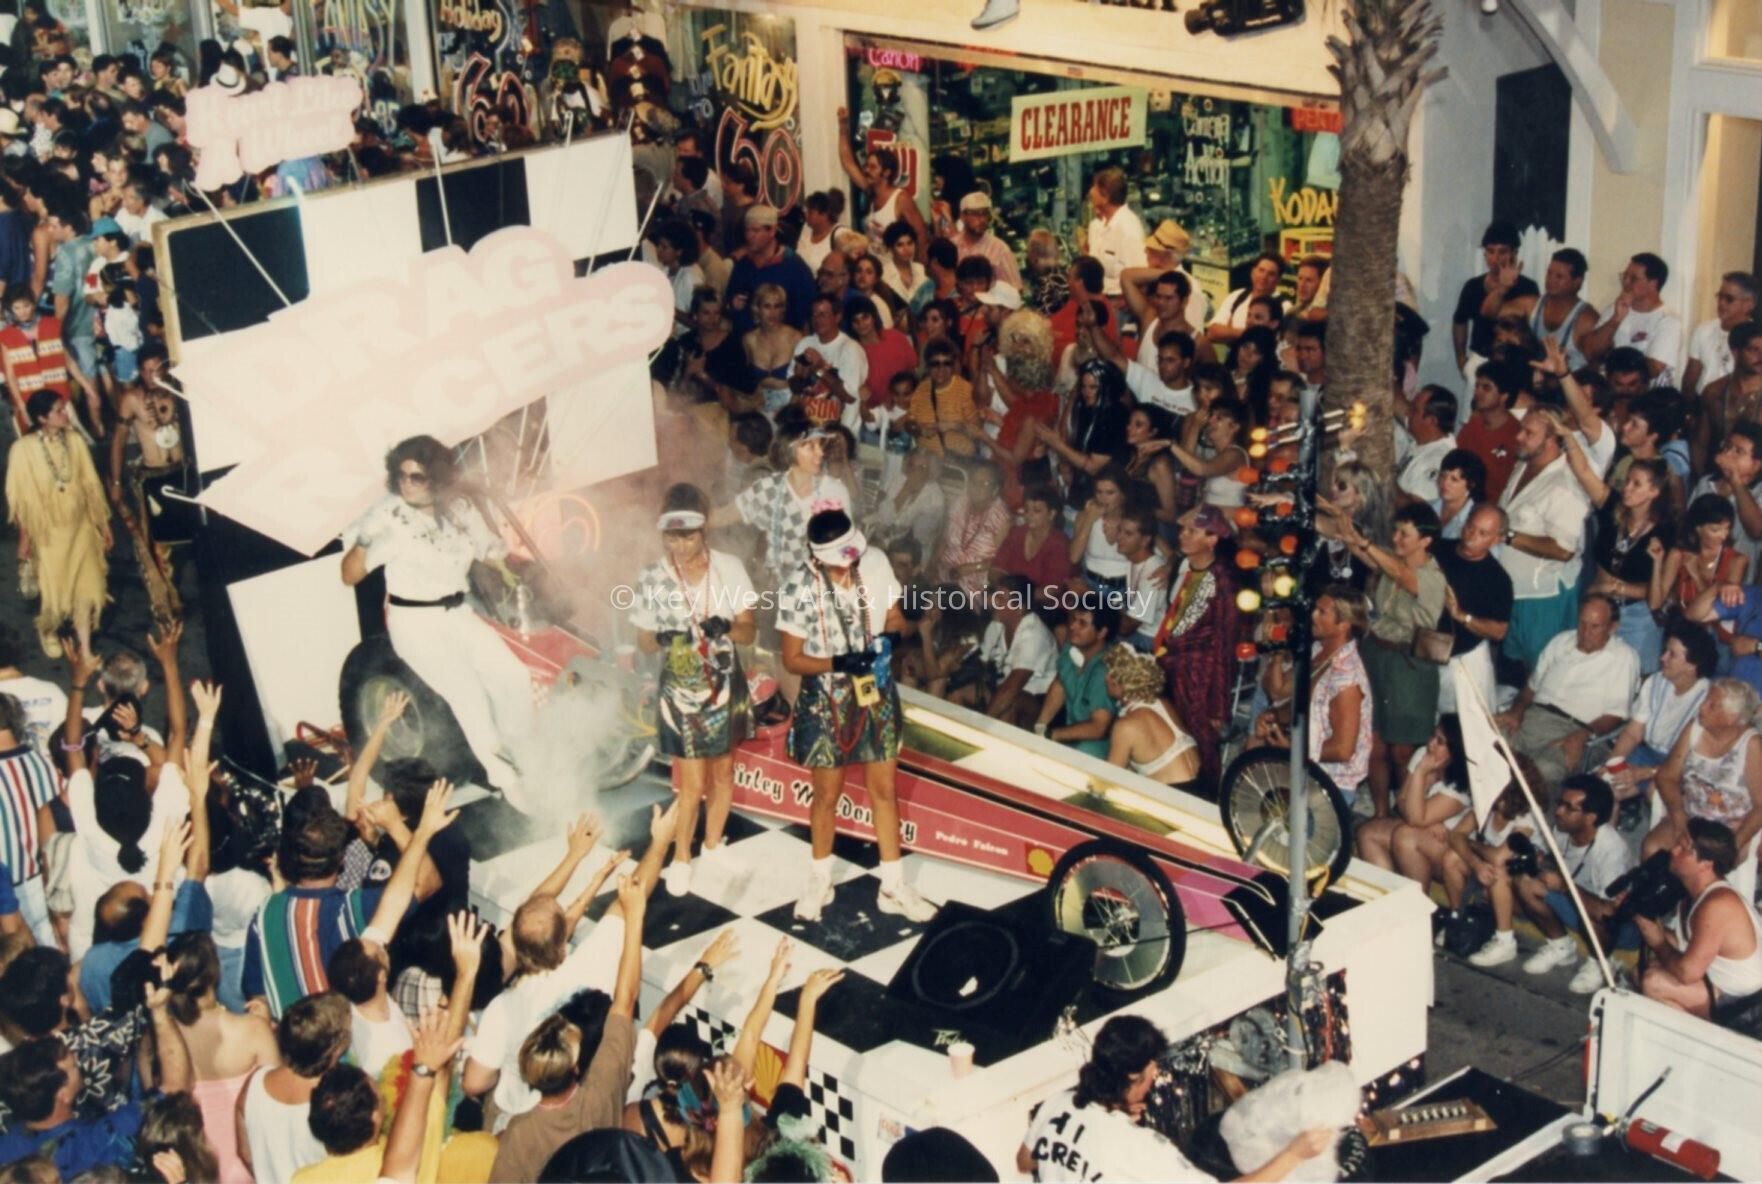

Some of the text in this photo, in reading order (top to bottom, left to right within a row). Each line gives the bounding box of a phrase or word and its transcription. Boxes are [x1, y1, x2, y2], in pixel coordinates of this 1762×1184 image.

[701, 24, 797, 132] Fantasy
[868, 48, 921, 72] Canon
[1021, 96, 1132, 151] CLEARANCE
[201, 239, 561, 427] DRAG
[733, 763, 784, 802] irley
